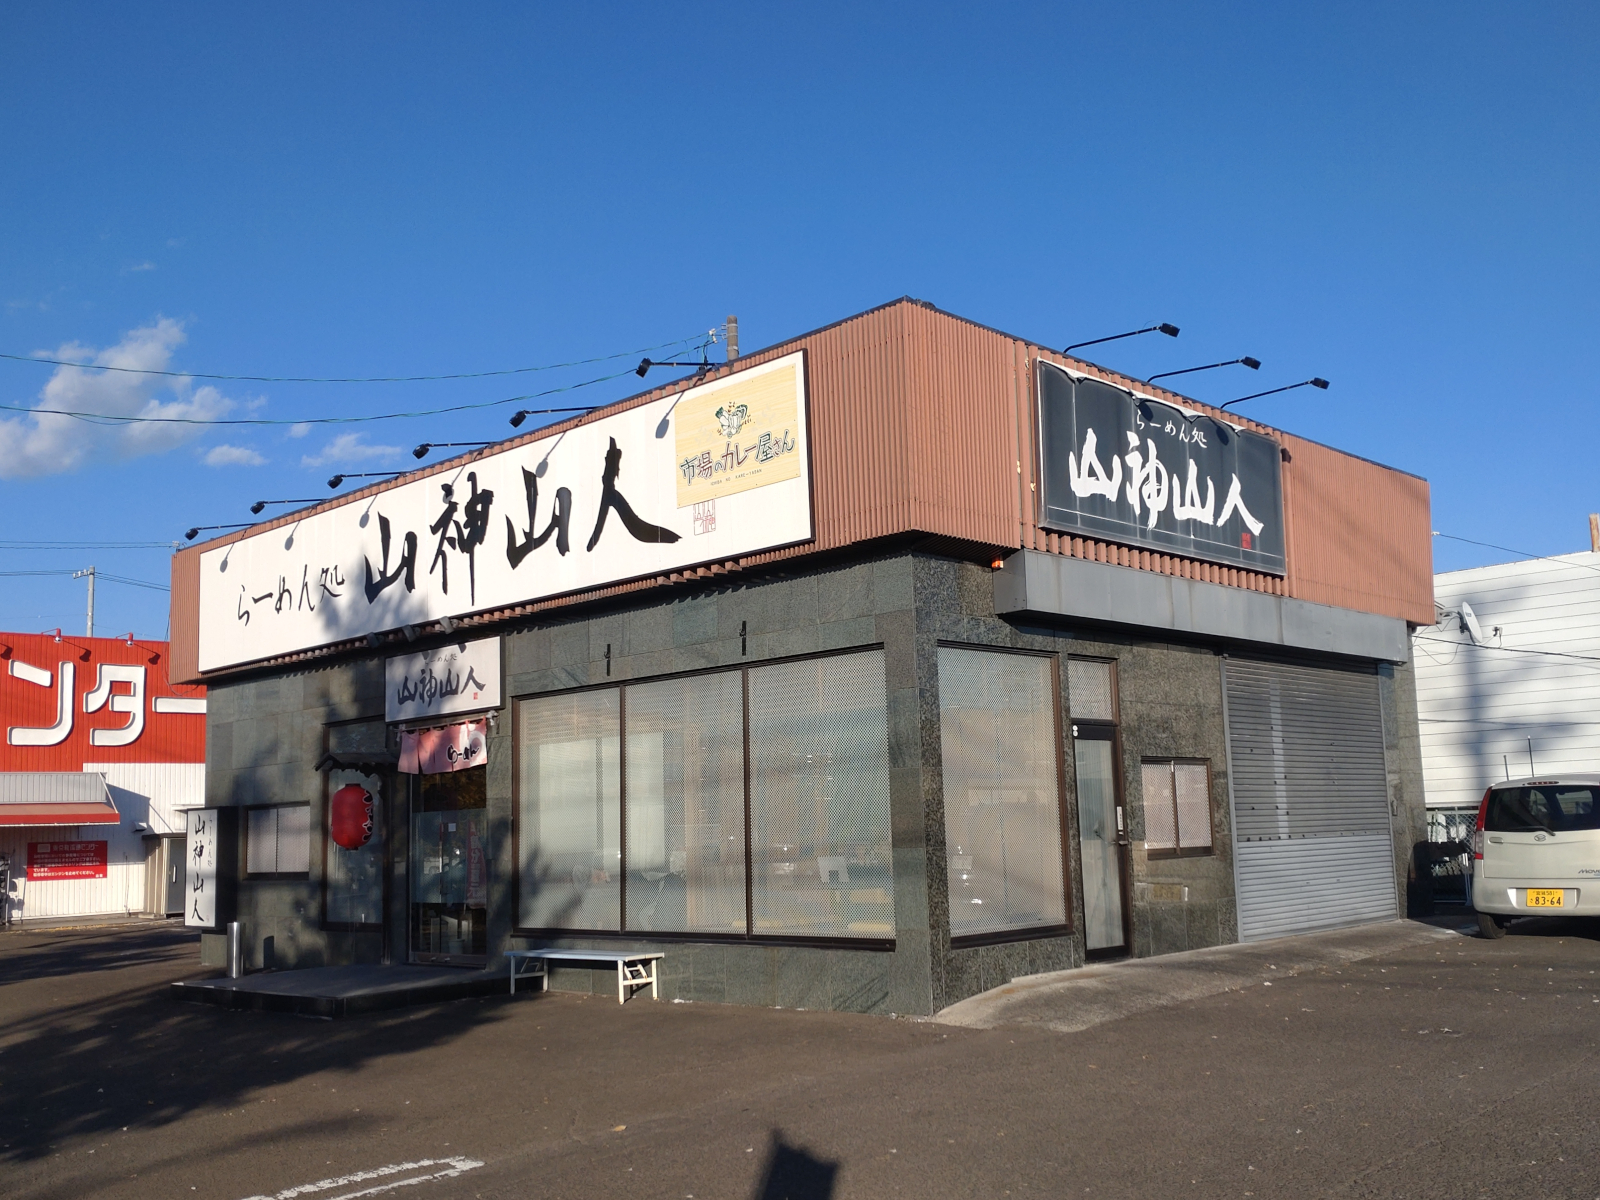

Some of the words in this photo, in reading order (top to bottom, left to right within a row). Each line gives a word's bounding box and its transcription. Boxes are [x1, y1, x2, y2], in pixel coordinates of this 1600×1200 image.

[680, 429, 795, 485] 市場のカレー屋さん
[1136, 409, 1208, 449] らーめん処
[1068, 428, 1264, 536] 山神山人
[363, 436, 683, 606] 山神山人
[236, 563, 346, 626] らーめん処
[7, 659, 207, 746] ンター
[397, 665, 486, 708] 山神山人
[446, 744, 480, 764] らーめん
[191, 813, 206, 922] 山神山人
[1535, 896, 1561, 906] 83-64
